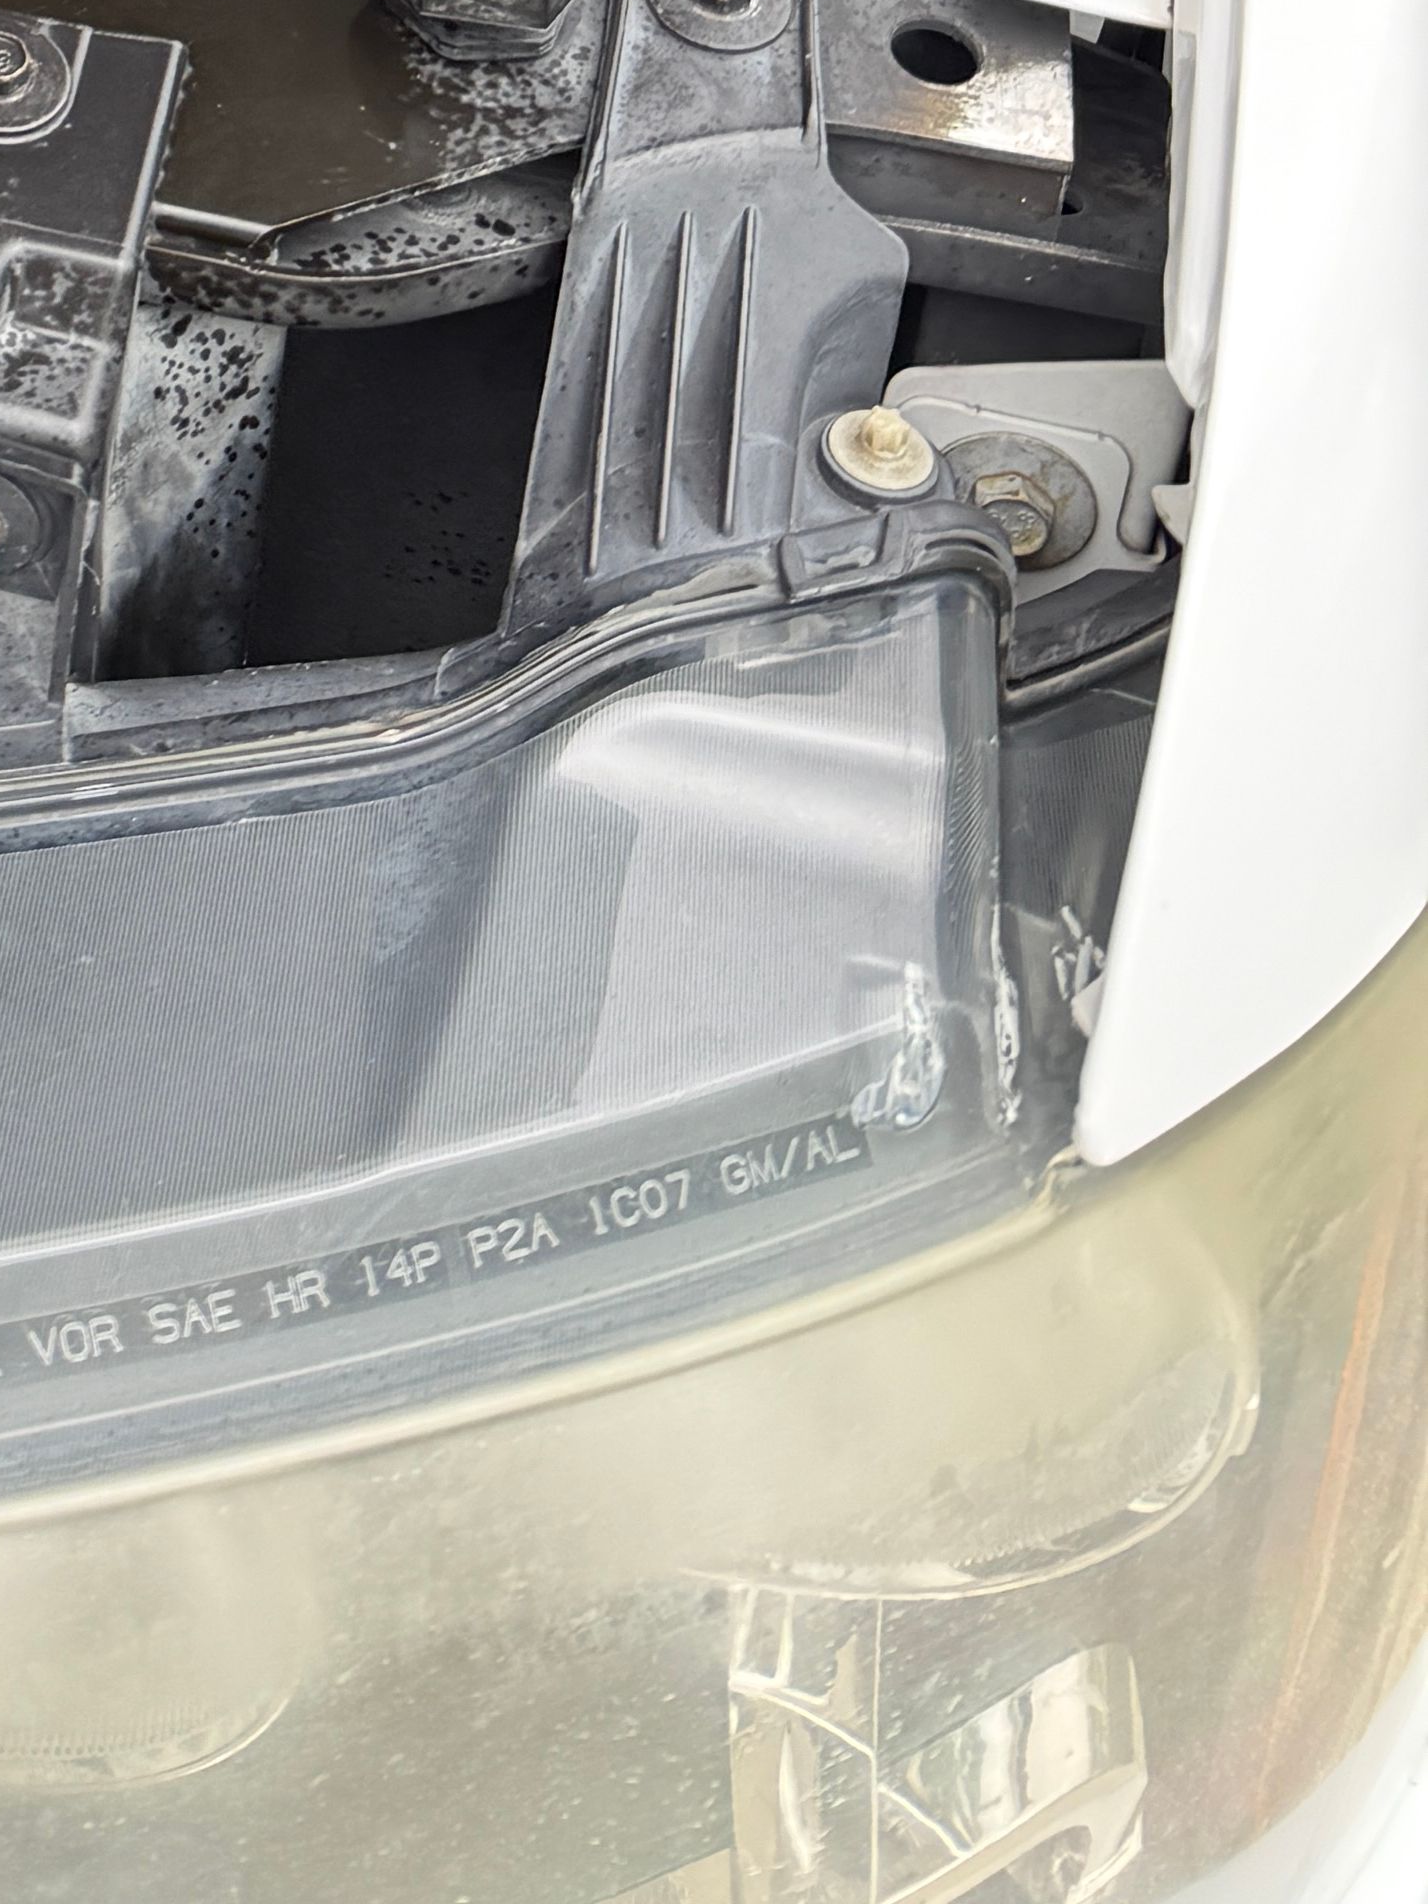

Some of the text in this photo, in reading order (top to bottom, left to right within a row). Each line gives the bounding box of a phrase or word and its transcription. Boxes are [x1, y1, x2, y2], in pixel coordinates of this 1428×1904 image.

[29, 1315, 123, 1366] VOR
[148, 1290, 242, 1344] SAE
[265, 1269, 331, 1319] HR
[467, 1212, 559, 1268] P2A
[720, 1124, 861, 1195] GM/AL
